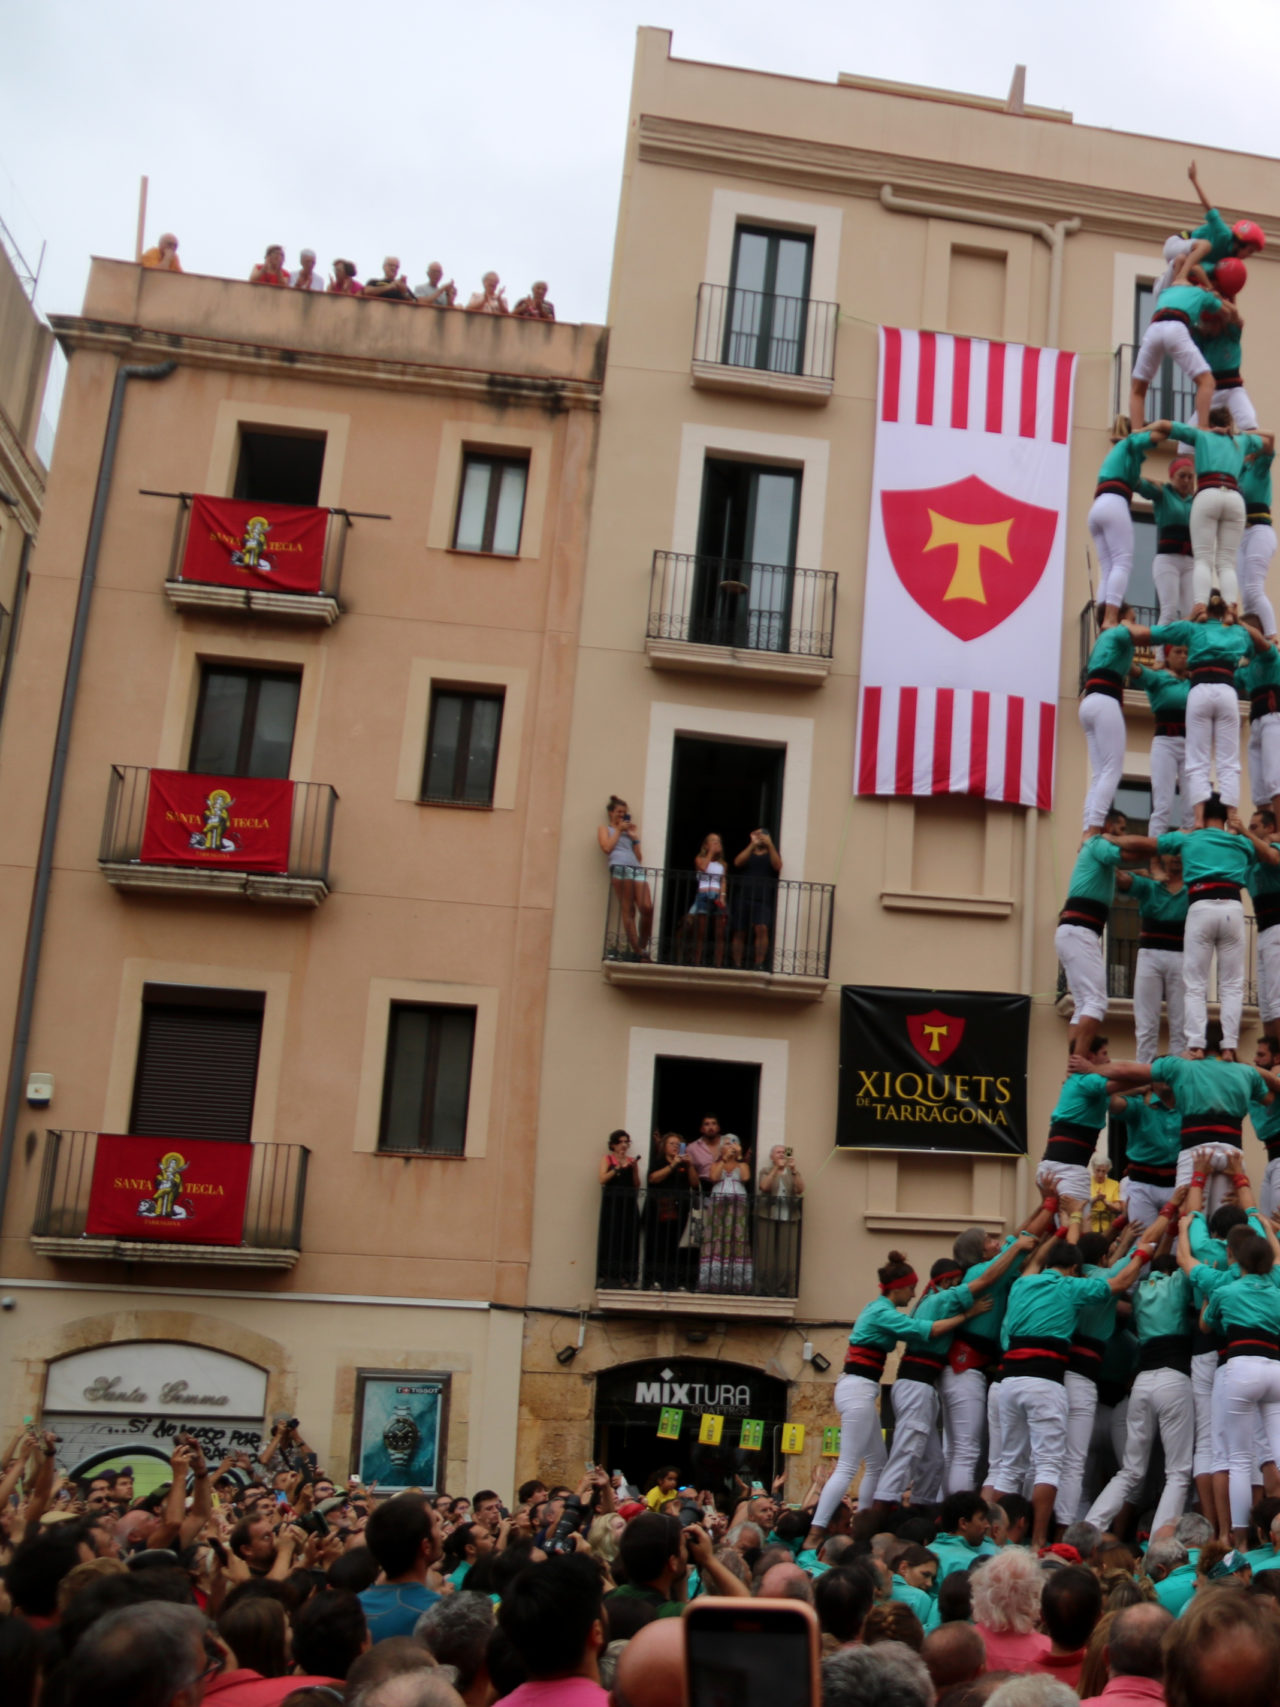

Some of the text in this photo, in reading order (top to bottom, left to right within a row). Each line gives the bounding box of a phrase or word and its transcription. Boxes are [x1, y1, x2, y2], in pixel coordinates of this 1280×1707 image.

[269, 541, 303, 552] TECLA
[166, 811, 270, 828] SANTA TECLA
[856, 1071, 1011, 1107] XIQUETS
[856, 1097, 870, 1106] DE
[872, 1103, 1008, 1126] TARRAGONA
[113, 1178, 224, 1195] SANTA TECLA
[83, 1376, 231, 1405] Santa Gemma
[635, 1382, 750, 1405] MIXTURA
